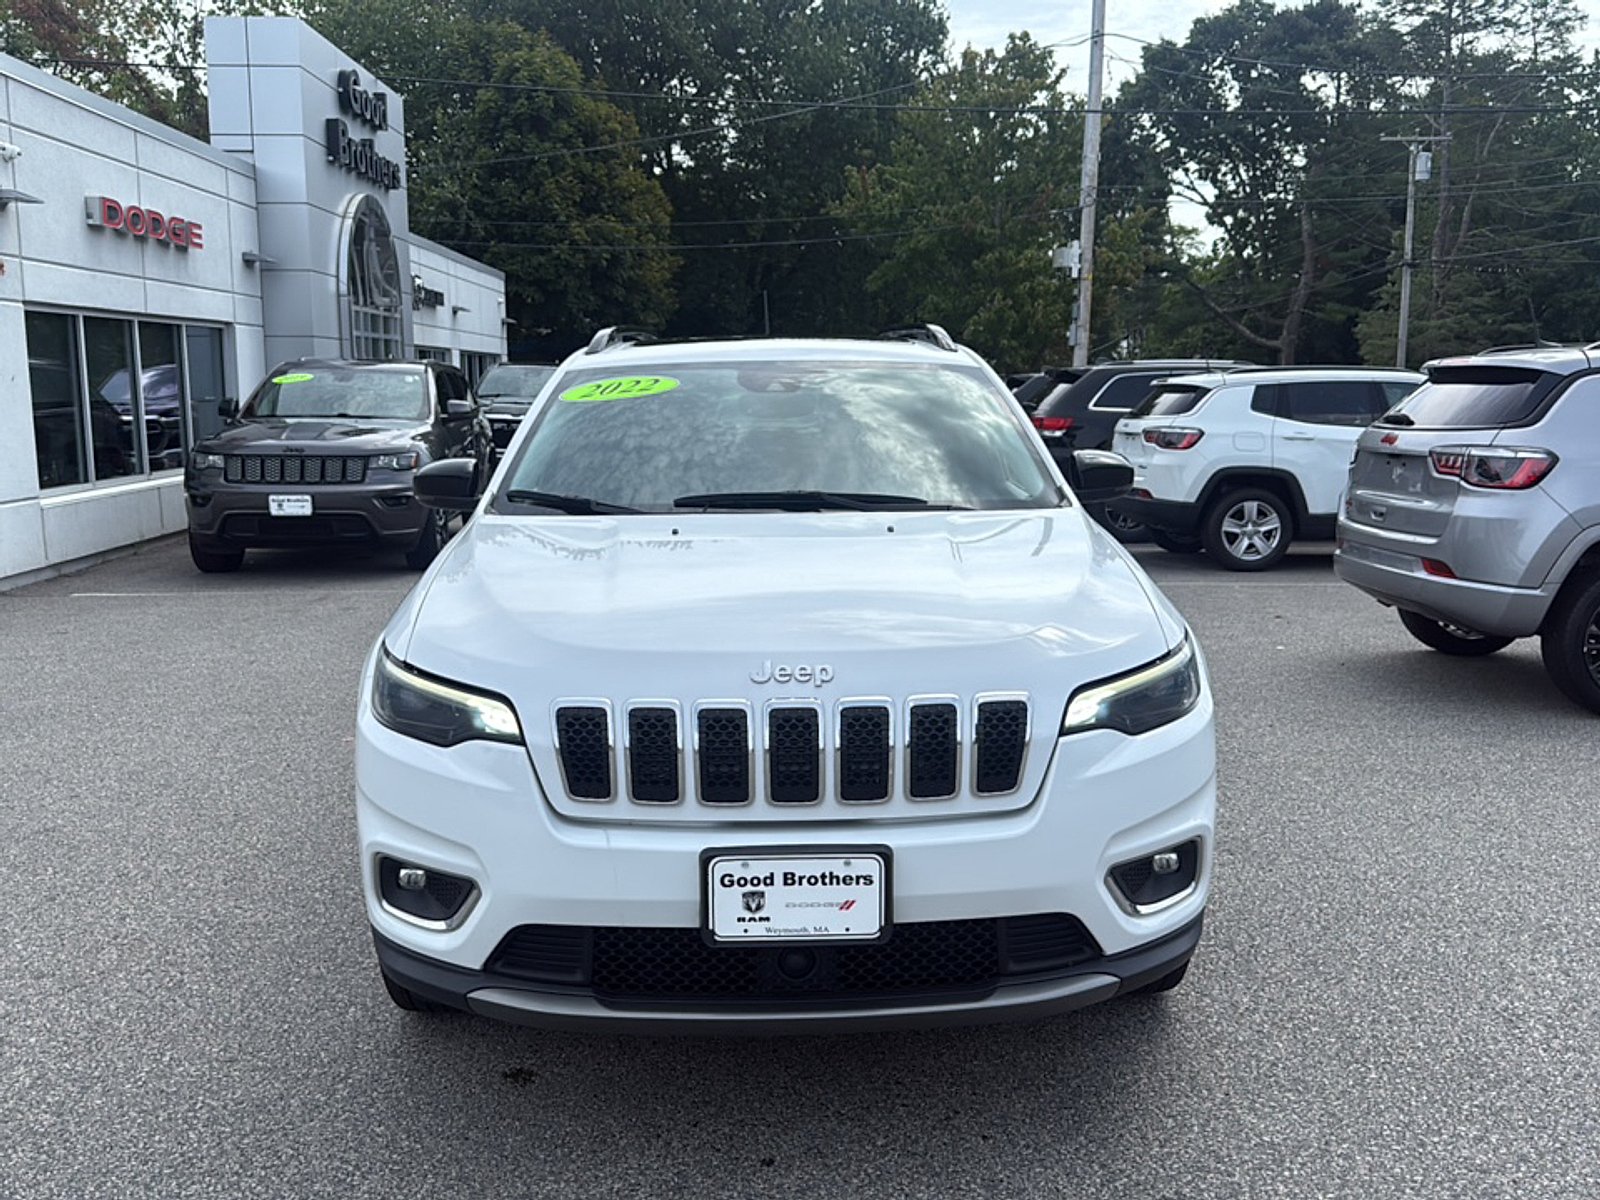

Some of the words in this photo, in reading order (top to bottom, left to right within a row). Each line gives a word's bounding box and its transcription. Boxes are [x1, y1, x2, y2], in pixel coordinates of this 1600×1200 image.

[338, 69, 388, 131] Good
[326, 118, 401, 190] Brothers
[99, 197, 204, 249] DODGE
[579, 378, 660, 399] 2022
[749, 659, 834, 687] Jeep
[720, 872, 775, 888] Good
[783, 871, 874, 887] Brothers
